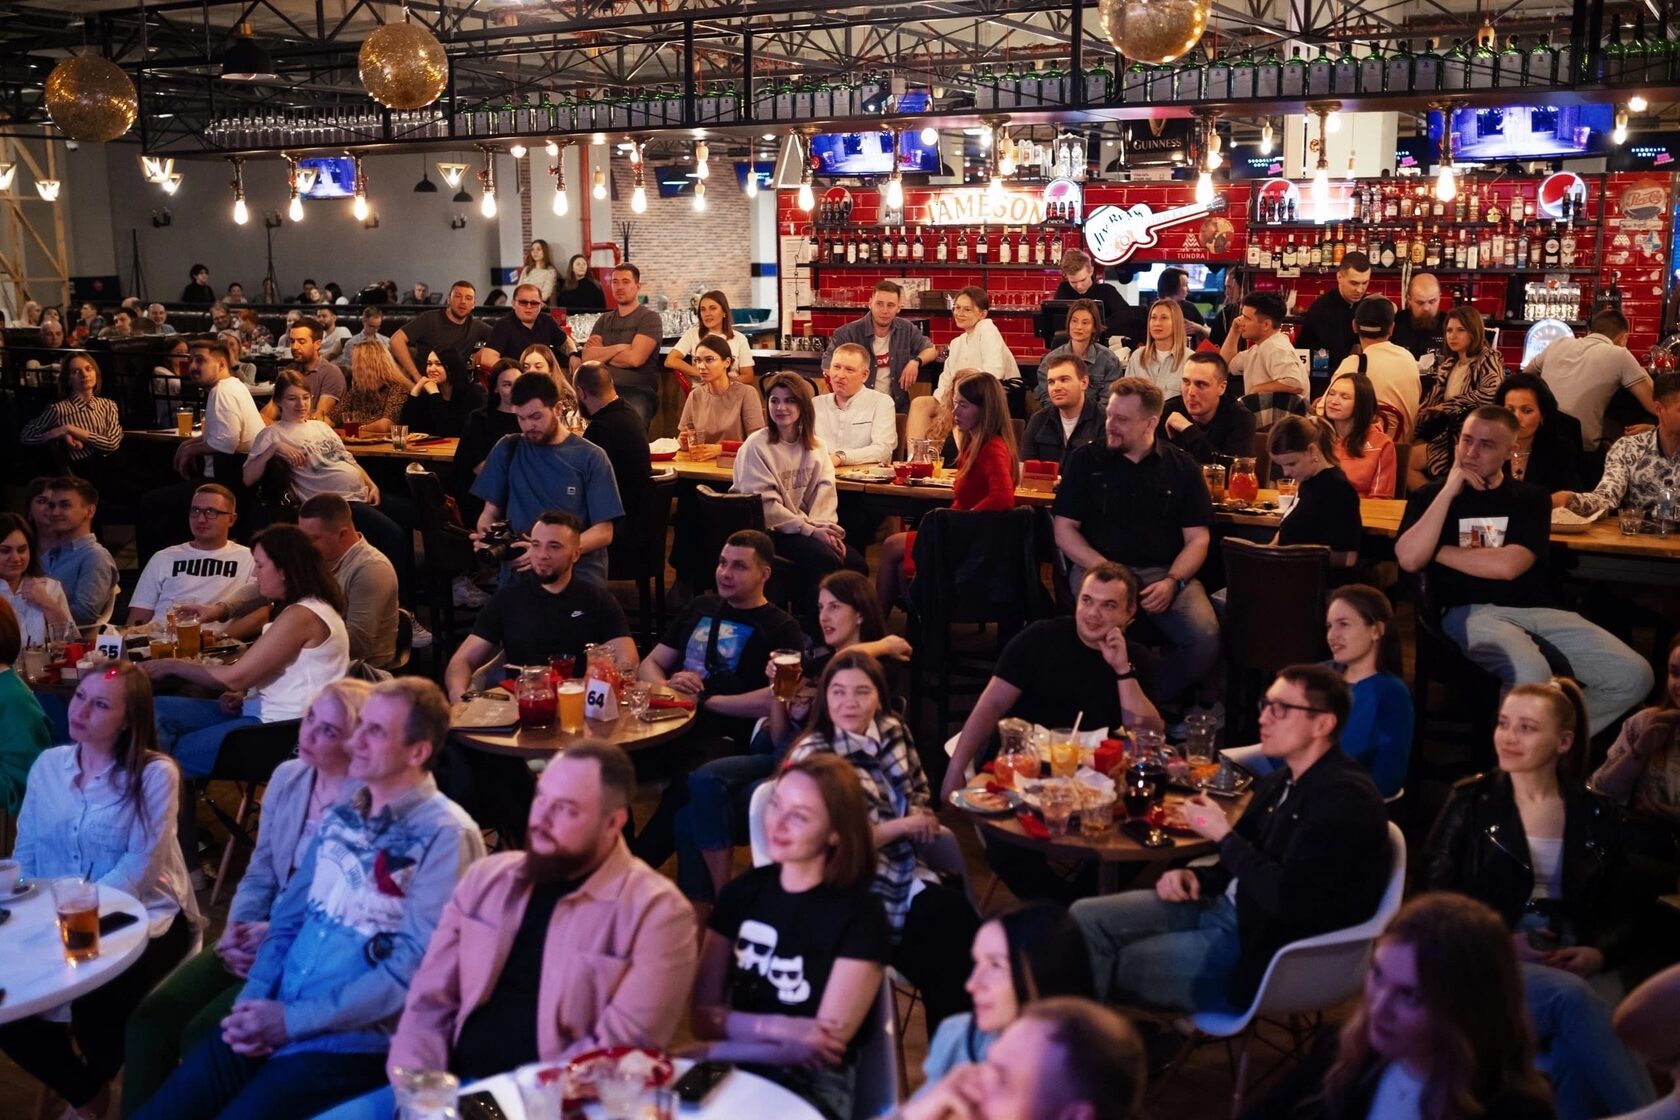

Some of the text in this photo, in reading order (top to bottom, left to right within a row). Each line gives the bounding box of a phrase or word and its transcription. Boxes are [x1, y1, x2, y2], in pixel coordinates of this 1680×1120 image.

[1133, 138, 1182, 150] GUINNESS
[927, 194, 1044, 224] JAMESON
[172, 558, 238, 578] PUMA
[587, 691, 604, 708] 64
